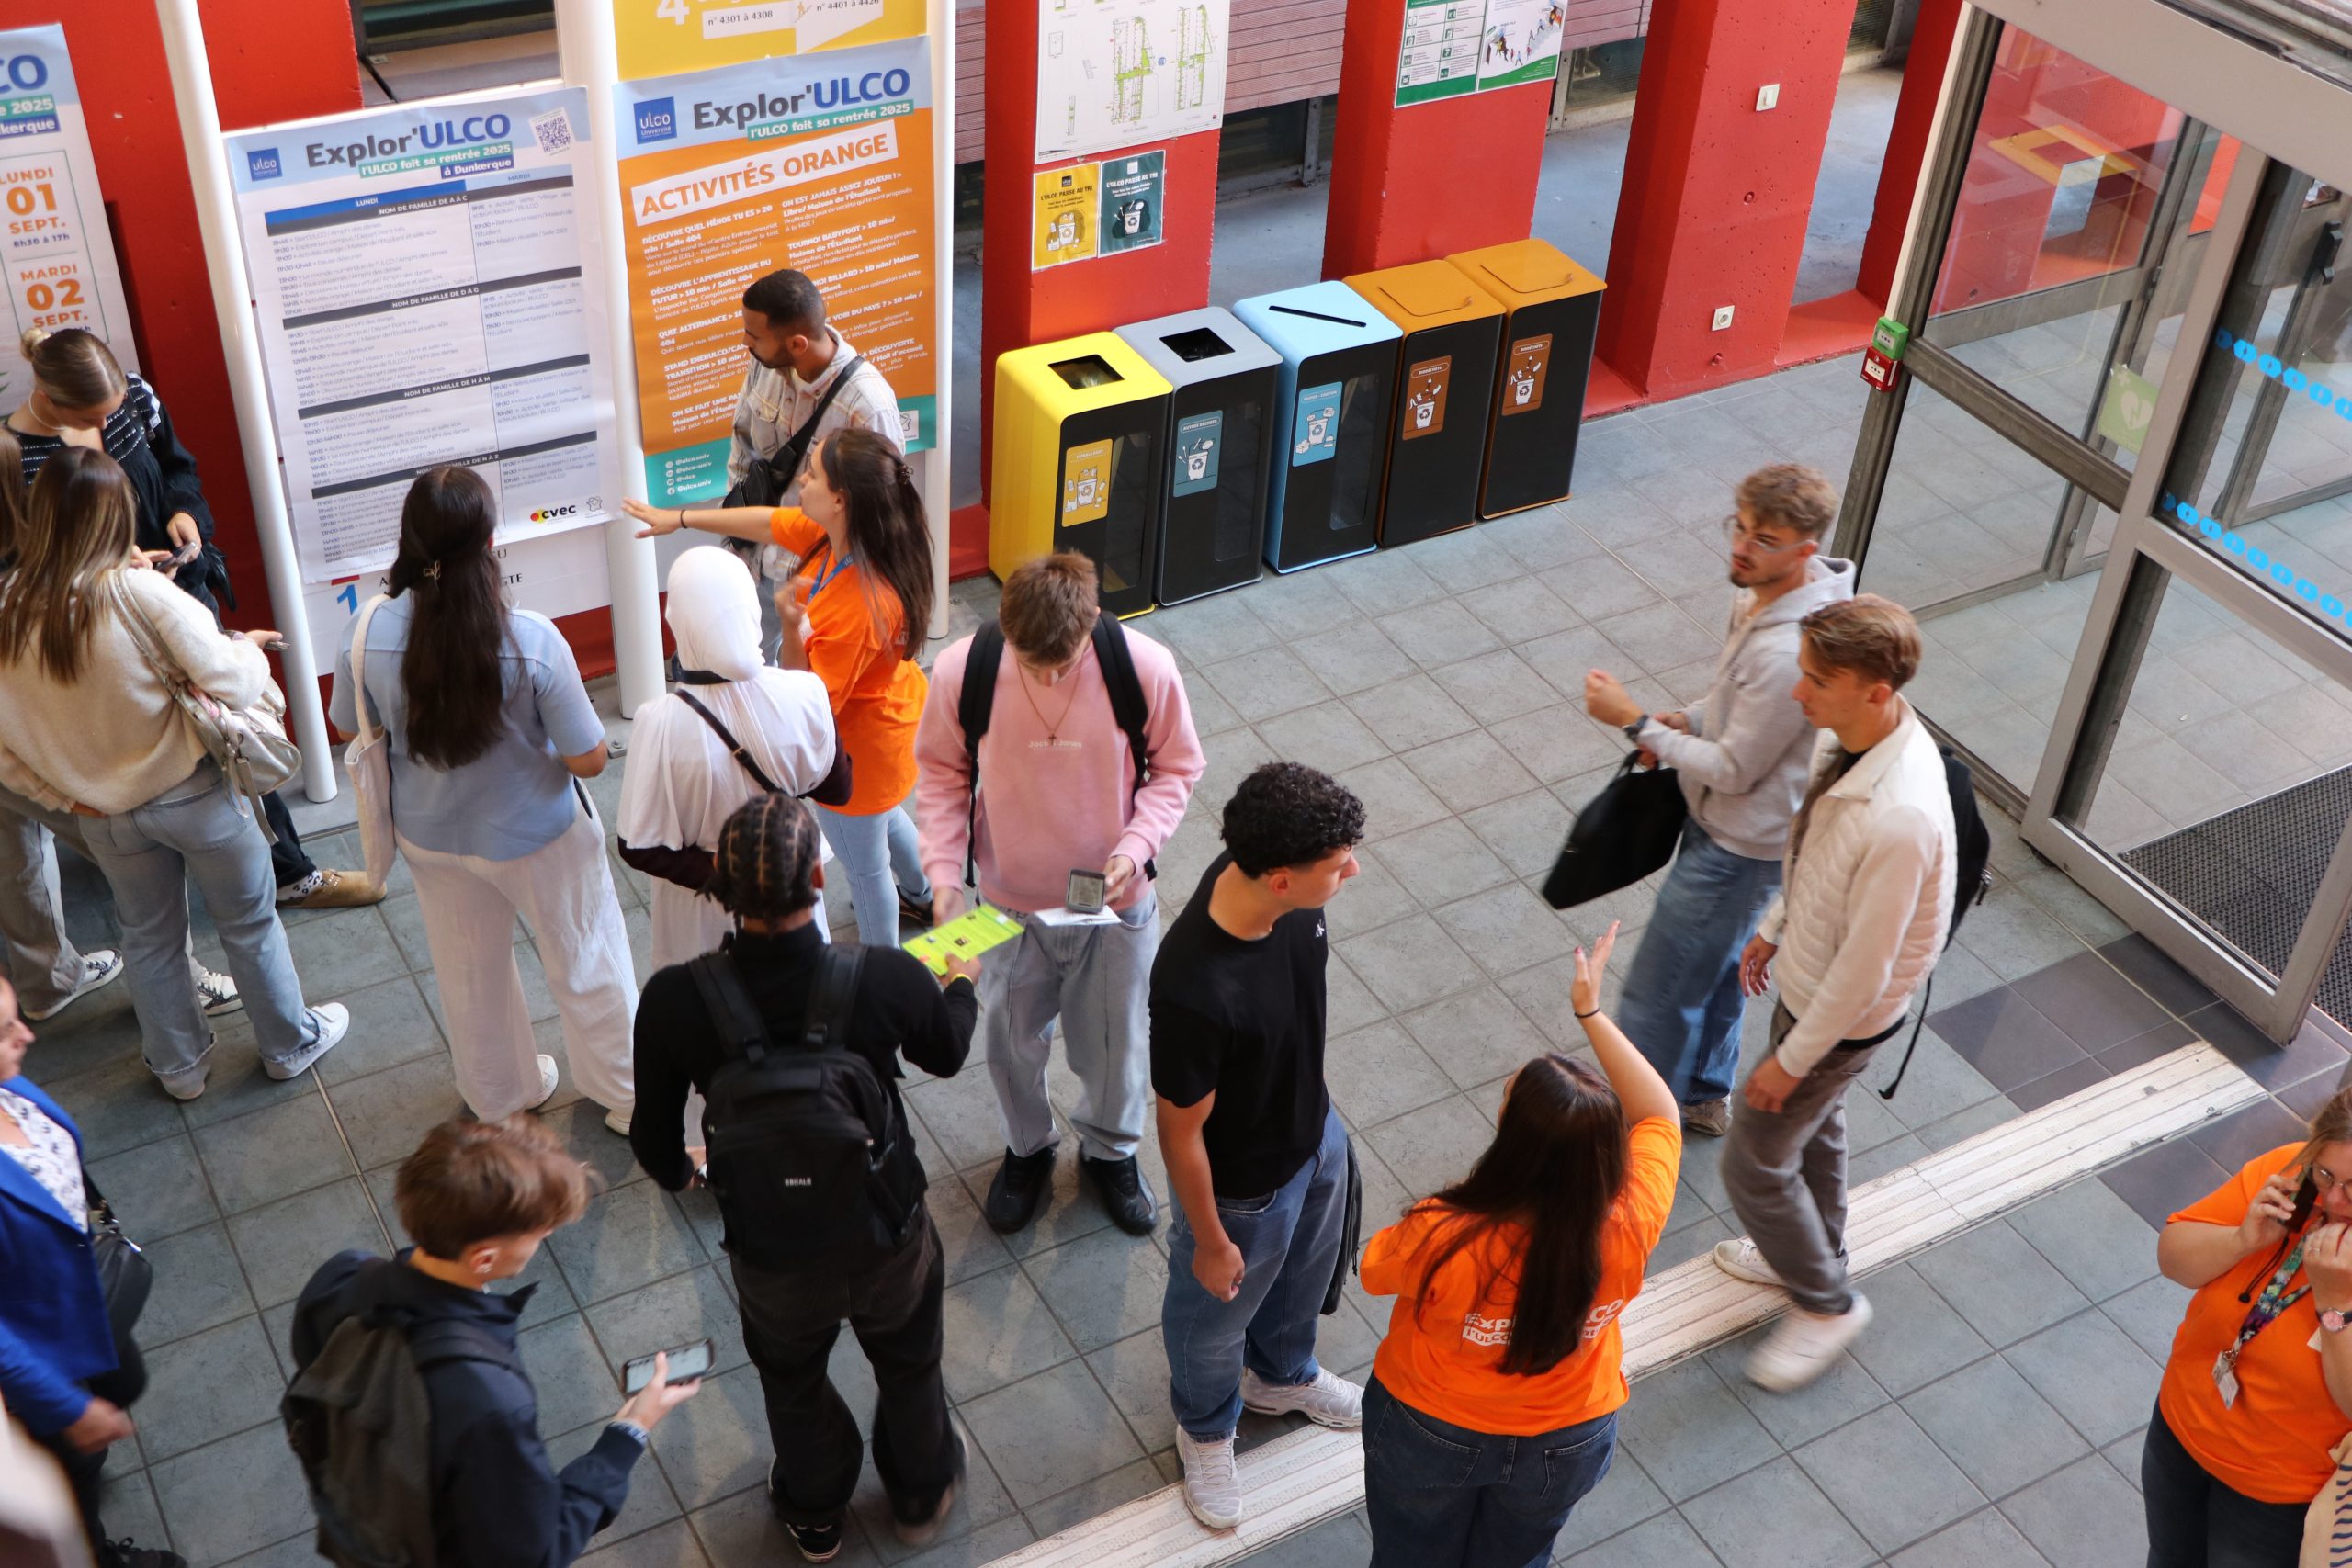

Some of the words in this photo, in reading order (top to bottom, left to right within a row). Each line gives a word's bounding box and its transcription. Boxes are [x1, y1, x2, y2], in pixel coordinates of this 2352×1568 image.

[828, 1, 849, 10] 4401
[719, 16, 741, 24] 4301
[743, 13, 749, 21] à
[751, 10, 773, 20] 4308
[12, 97, 53, 115] 2025
[693, 68, 910, 130] Explor'ULCO
[792, 118, 813, 133] fait
[817, 119, 830, 130] sa
[833, 108, 877, 128] rentrée
[880, 102, 910, 116] 2025
[306, 113, 511, 168] Explor'ULCO
[401, 157, 421, 171] fait
[424, 157, 435, 166] sa
[439, 147, 480, 164] rentrée
[482, 144, 512, 157] 2025
[444, 164, 451, 176] à
[454, 157, 513, 177] Dunkerque
[507, 173, 531, 183] MARDI
[641, 162, 775, 217] ACTIVITÉS
[783, 133, 888, 177] ORANGE
[6, 183, 57, 216] 01
[781, 198, 794, 208] ON
[794, 195, 808, 205] EST
[809, 187, 837, 200] JAMAIS
[838, 181, 861, 193] ASSEZ
[862, 173, 892, 186] JOUEUR
[807, 197, 833, 210] Maison
[834, 195, 844, 203] de
[844, 183, 881, 200] l'Étudiant
[356, 197, 379, 208] LUNDI
[378, 206, 396, 215] NOM
[396, 204, 407, 212] DE
[407, 199, 435, 210] FAMILLE
[435, 197, 447, 206] DE
[8, 217, 66, 235] SEPT.
[641, 226, 684, 244] DÉCOUVRE
[684, 221, 706, 234] QUEL
[706, 213, 731, 228] HÉROS
[733, 211, 744, 220] TU
[744, 209, 755, 217] ES
[762, 204, 773, 213] 20
[787, 235, 820, 250] TOURNOI
[821, 224, 860, 241] BABYFOOT
[867, 220, 877, 229] 10
[878, 215, 896, 226] min/
[643, 244, 658, 254] min
[666, 237, 684, 248] Salle
[685, 233, 701, 243] 404
[788, 246, 815, 259] Maison
[816, 243, 826, 252] de
[826, 231, 863, 249] l'Étudiant
[20, 264, 78, 281] MARDI
[650, 277, 692, 297] DÉCOUVRE
[692, 261, 759, 286] L'APPRENTISSAGE
[759, 258, 771, 267] DU
[827, 269, 858, 283] BILLARD
[865, 264, 875, 273] 10
[875, 259, 891, 270] min/
[893, 252, 919, 265] Maison
[27, 278, 85, 311] 02
[391, 299, 409, 308] NOM
[410, 297, 420, 305] DE
[420, 291, 448, 303] FAMILLE
[449, 289, 459, 298] DE
[652, 293, 678, 306] FUTUR
[684, 288, 695, 297] 10
[696, 284, 710, 293] min
[718, 276, 736, 288] Salle
[737, 273, 752, 282] 404
[832, 310, 850, 321] VOIR
[851, 307, 862, 316] DU
[863, 302, 881, 312] PAYS
[893, 296, 903, 304] 10
[903, 292, 917, 301] min
[33, 310, 88, 328] SEPT.
[658, 327, 678, 340] QUIZ
[678, 313, 728, 333] ALTERNANCE
[660, 337, 676, 347] 404
[868, 338, 915, 355] DÉCOUVERTE
[876, 352, 890, 362] Hall
[891, 343, 923, 358] d'accueil
[663, 358, 688, 372] STAND
[665, 361, 711, 380] TRANSITION
[717, 357, 727, 366] 10
[728, 353, 741, 362] min
[403, 388, 421, 398] NOM
[421, 386, 432, 394] DE
[432, 380, 459, 392] FAMILLE
[460, 378, 469, 387] DE
[671, 409, 683, 418] ON
[684, 406, 694, 414] SE
[695, 400, 710, 411] FAIT
[711, 396, 727, 406] UNE
[673, 412, 698, 427] Maison
[700, 410, 709, 419] de
[541, 505, 576, 519] cvec
